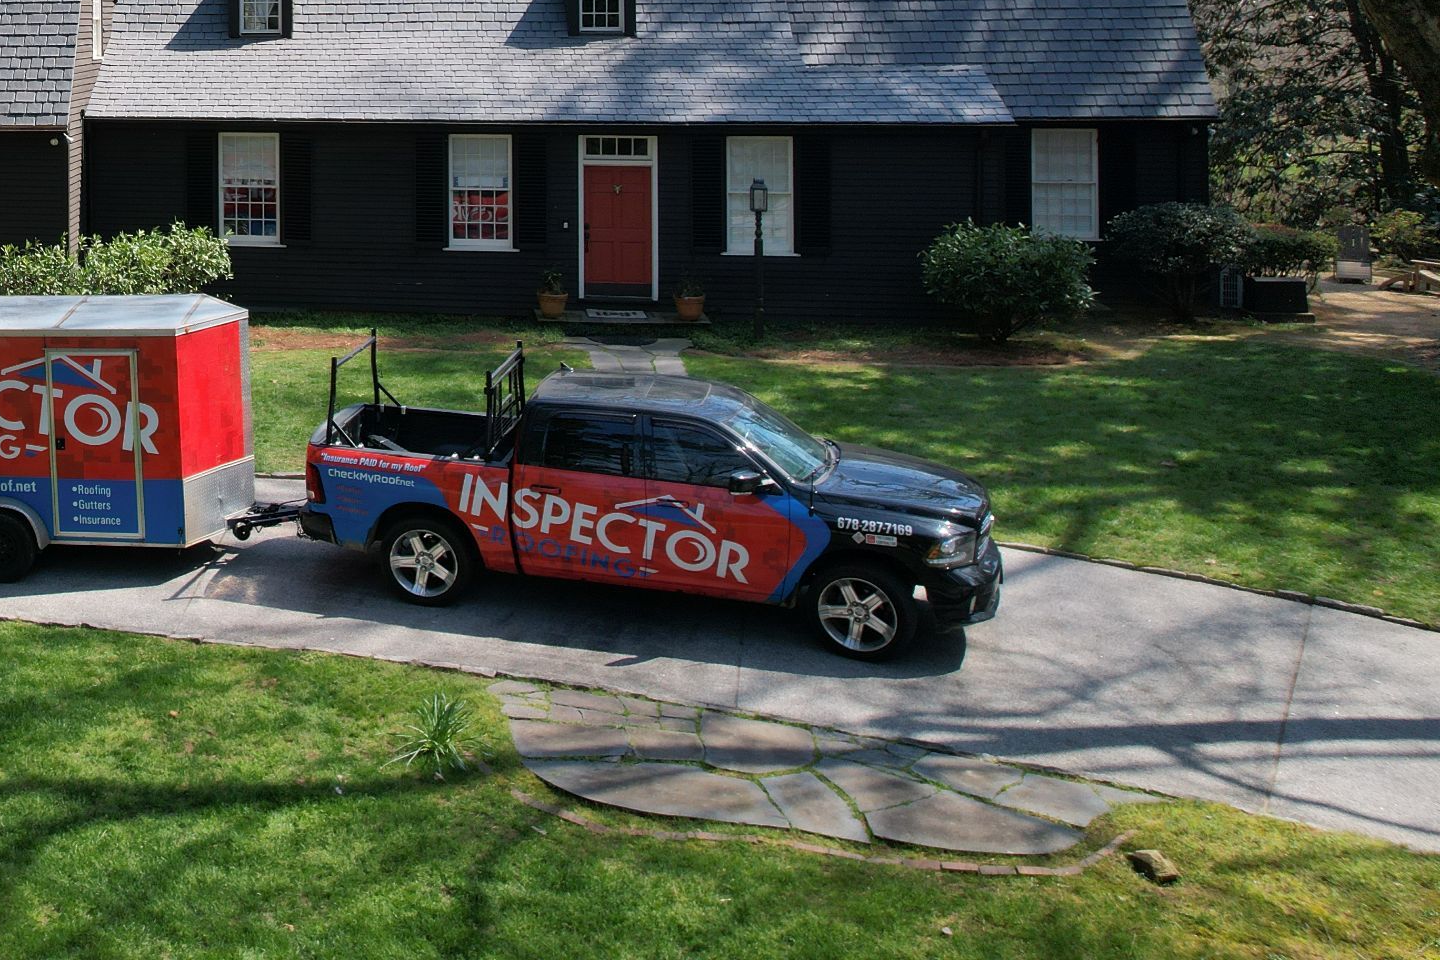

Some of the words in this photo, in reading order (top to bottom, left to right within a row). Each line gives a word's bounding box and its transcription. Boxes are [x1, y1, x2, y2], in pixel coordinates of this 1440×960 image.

[359, 457, 378, 467] PAID
[378, 460, 390, 469] for
[391, 462, 403, 471] my
[77, 484, 111, 498] Roofing
[78, 499, 111, 511] Gutters
[79, 514, 121, 526] Insurance
[837, 517, 913, 537] 678-287-7169
[459, 473, 750, 585] INSPECTOR
[491, 524, 637, 578] ROOFING
